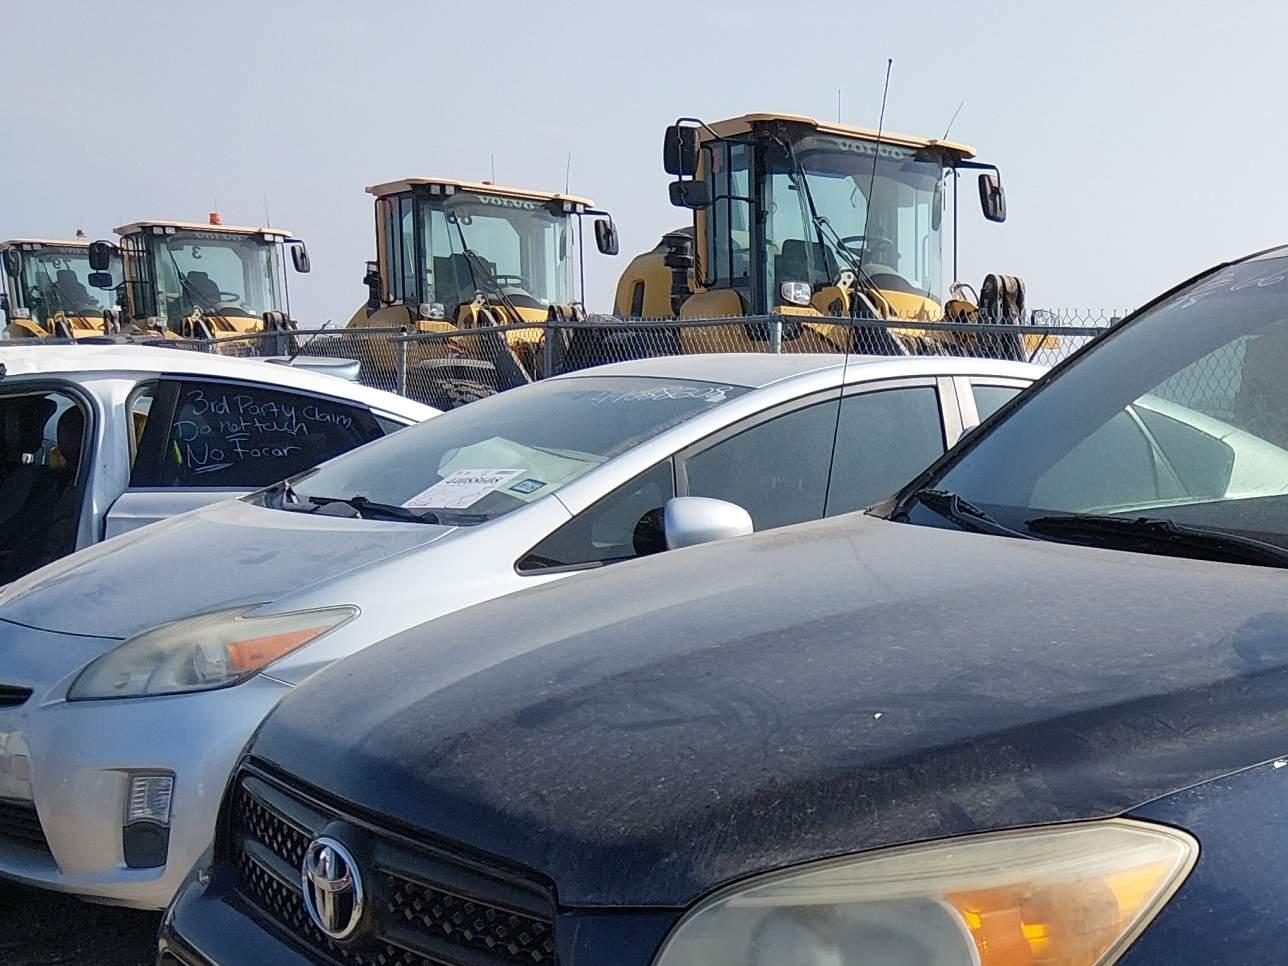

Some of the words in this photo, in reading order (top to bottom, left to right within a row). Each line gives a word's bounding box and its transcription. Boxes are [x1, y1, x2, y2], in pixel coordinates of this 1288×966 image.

[838, 141, 904, 160] VOLVO
[479, 196, 536, 210] VOLVO
[186, 390, 231, 416] 3rd
[232, 395, 296, 435] Party
[302, 404, 354, 430] Claim
[173, 420, 212, 442] Do
[219, 416, 251, 434] not
[186, 441, 225, 469] No
